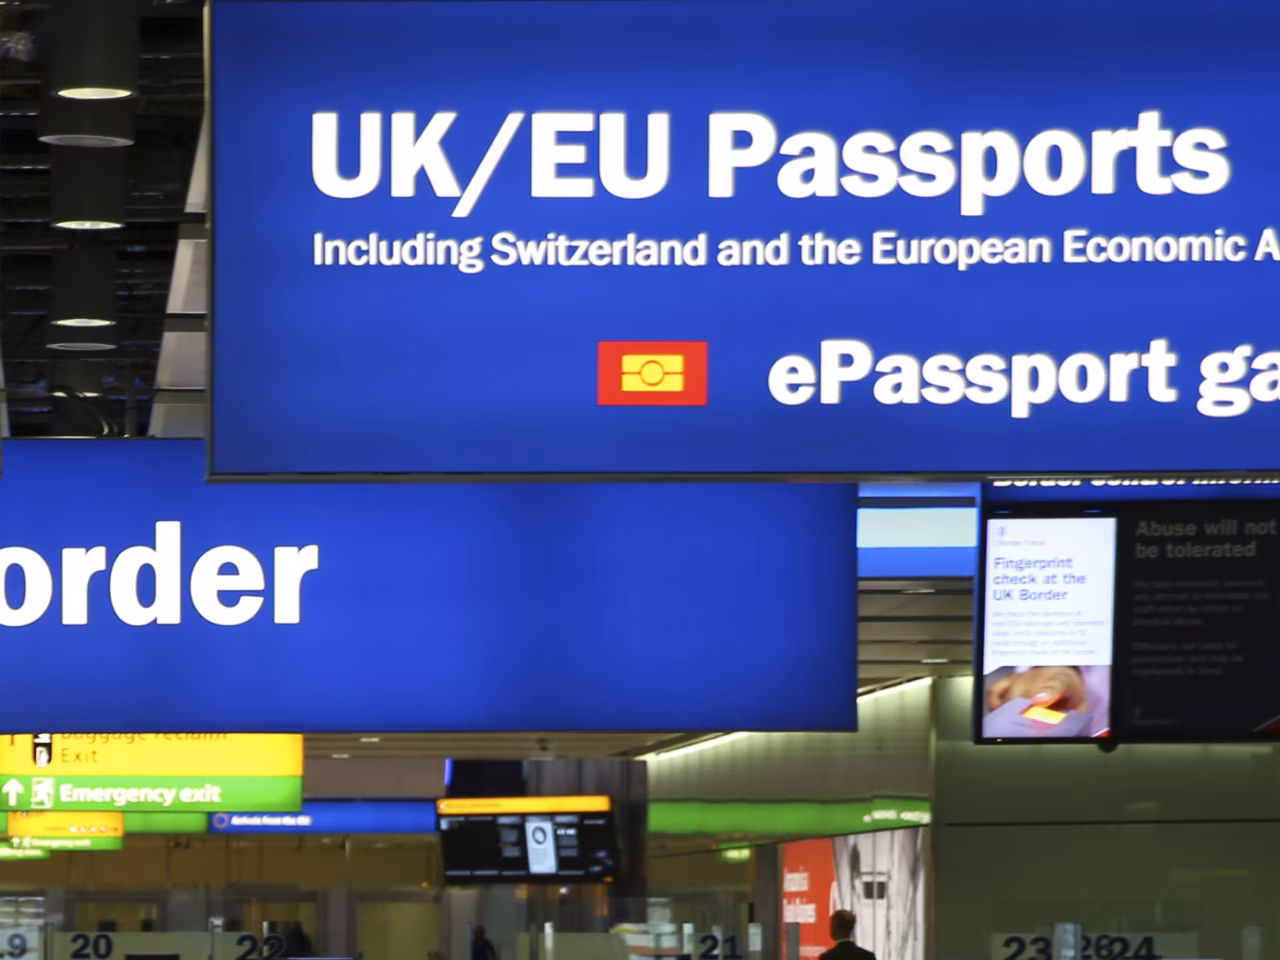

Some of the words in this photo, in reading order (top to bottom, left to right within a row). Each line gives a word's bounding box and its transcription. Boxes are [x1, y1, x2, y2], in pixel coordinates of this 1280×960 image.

[312, 111, 669, 217] UK/EU
[709, 110, 1231, 217] Passports
[313, 233, 484, 273] Including
[491, 232, 708, 267] Switzerland
[716, 233, 790, 266] and
[797, 232, 862, 266] the
[872, 231, 1052, 271] European
[1063, 228, 1247, 263] Economic
[767, 338, 1178, 419] ePassport
[1135, 520, 1198, 536] Abuse
[1203, 518, 1238, 535] will
[1244, 518, 1278, 535] not
[1135, 542, 1159, 558] be
[1165, 541, 1257, 558] tolerated
[993, 557, 1074, 571] Fingerprint
[993, 574, 1037, 585] check
[1042, 574, 1057, 585] at
[1063, 574, 1087, 585] the
[992, 589, 1013, 601] UK
[1019, 589, 1069, 601] Border
[61, 748, 99, 763] Exit
[59, 784, 176, 806] Emergency
[179, 784, 222, 803] exit
[71, 933, 113, 960] 20
[699, 935, 743, 960] 21
